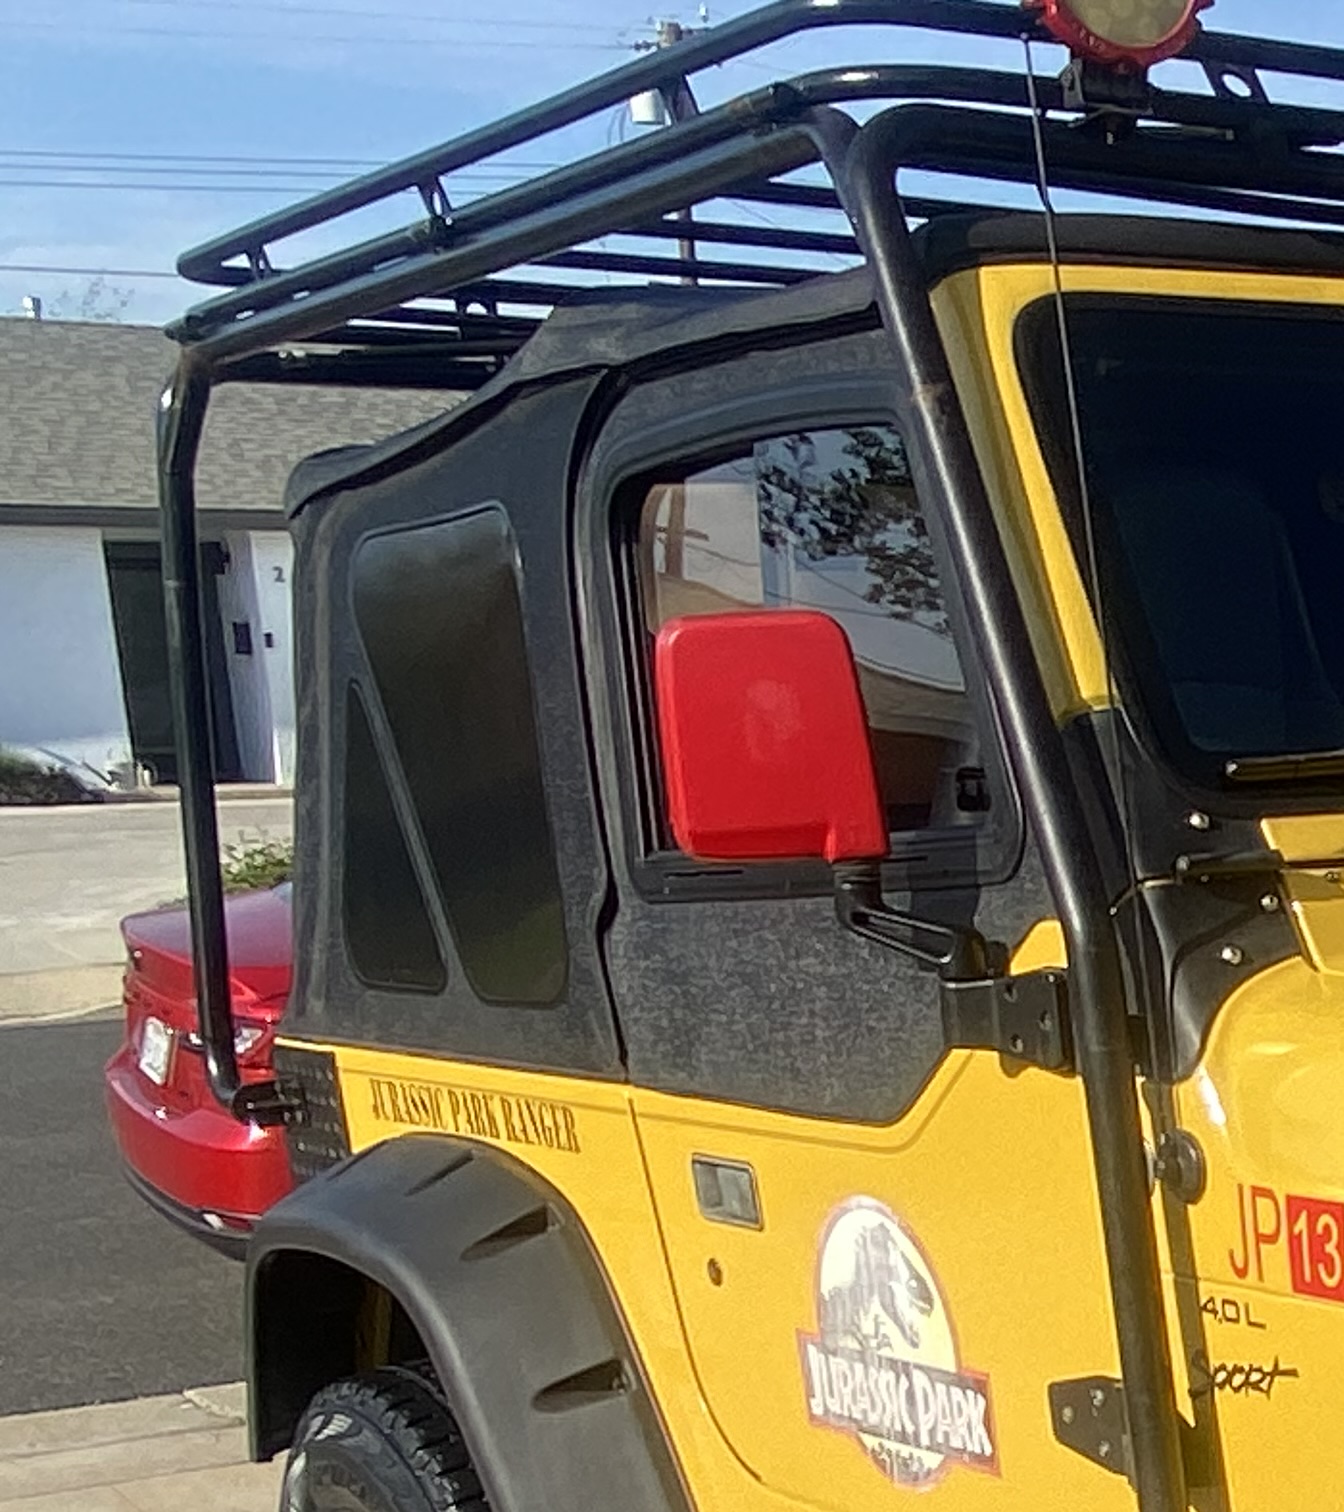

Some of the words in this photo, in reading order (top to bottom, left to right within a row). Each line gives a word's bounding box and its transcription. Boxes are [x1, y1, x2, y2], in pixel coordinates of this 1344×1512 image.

[369, 1077, 449, 1131] JURASSIC
[449, 1088, 501, 1140] PARK
[499, 1096, 582, 1154] RANGER
[1227, 1183, 1282, 1284] JP
[1292, 1208, 1344, 1289] 13
[807, 1342, 916, 1436] JURASSIC
[911, 1368, 993, 1457] PARK
